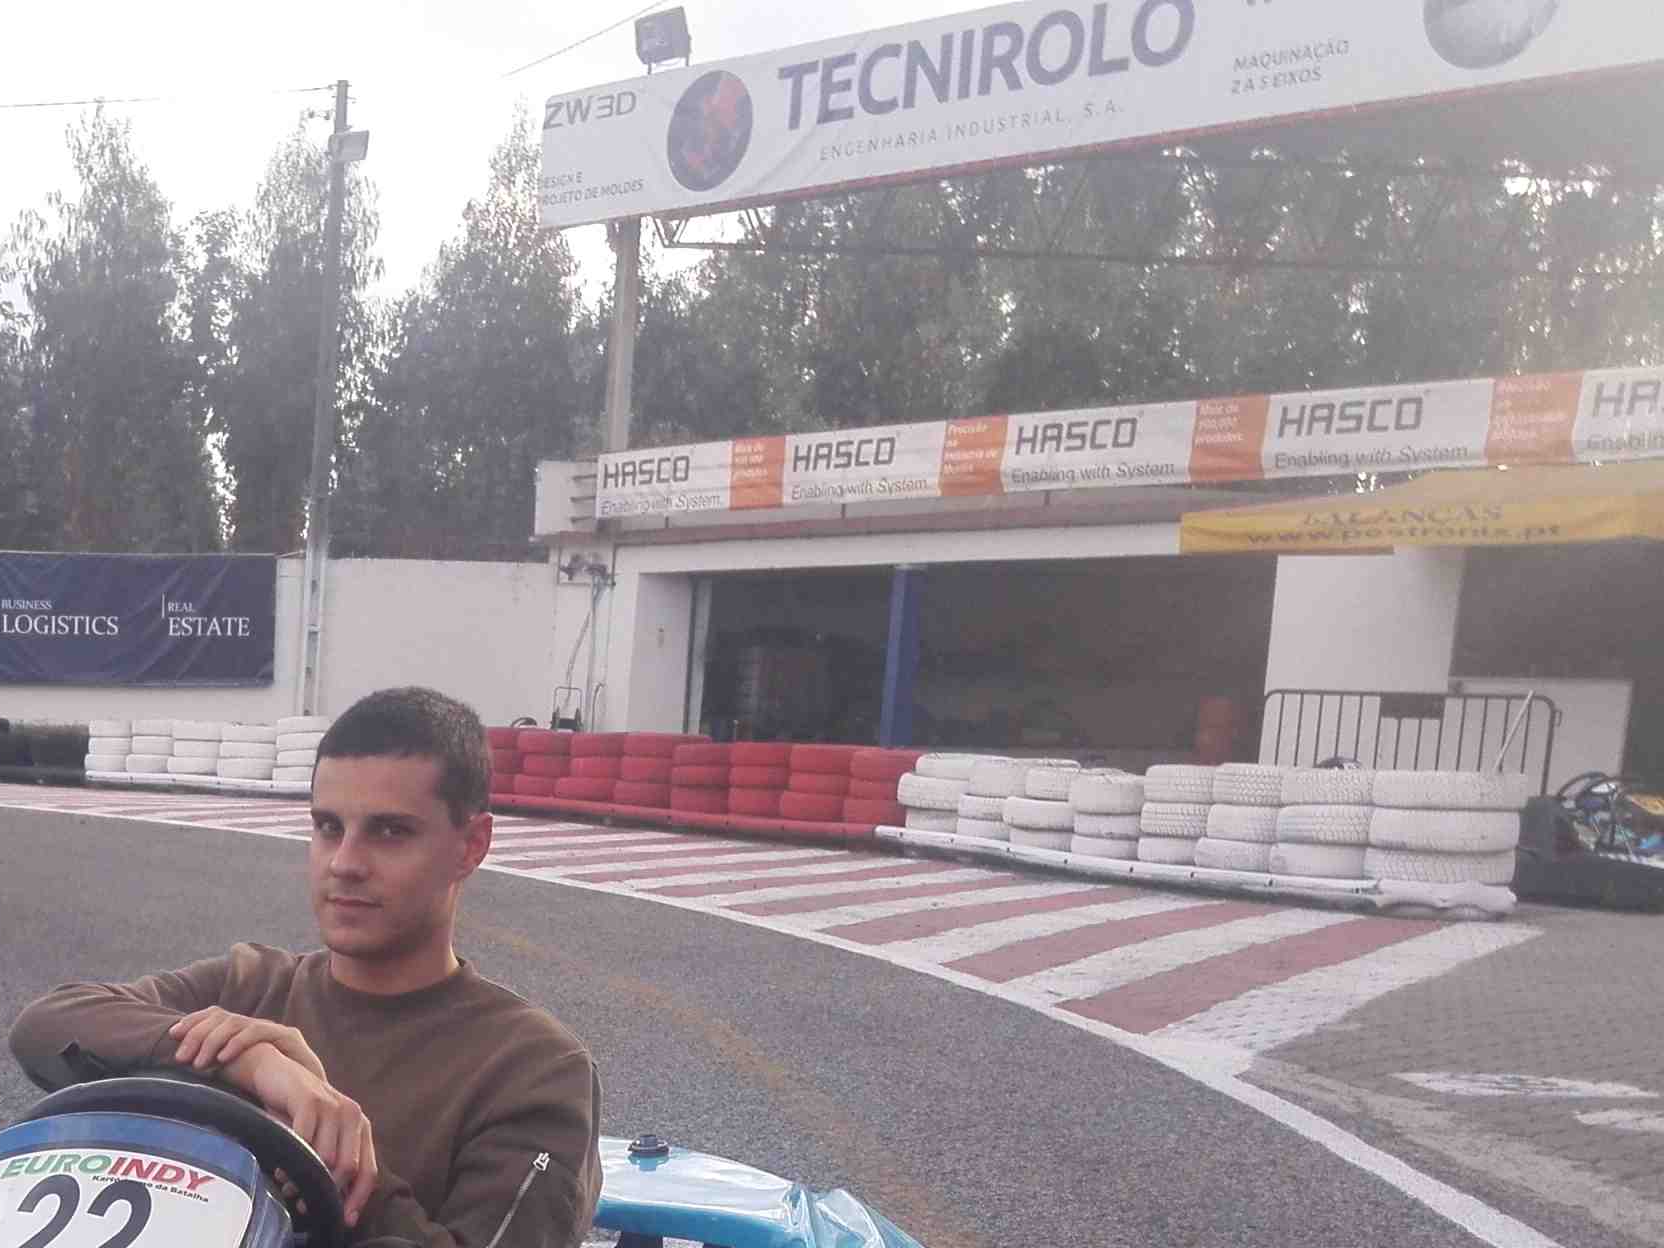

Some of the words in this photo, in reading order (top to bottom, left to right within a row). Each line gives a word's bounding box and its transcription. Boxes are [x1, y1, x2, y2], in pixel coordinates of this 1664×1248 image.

[778, 0, 1196, 131] TECNIROLO
[819, 128, 938, 161] ENGENHARIA
[1592, 379, 1664, 417] HA
[1277, 396, 1424, 438] HASCO
[1015, 417, 1138, 455] HASCO
[792, 436, 896, 473] HASCO
[1274, 452, 1351, 470] Enabling
[1355, 449, 1392, 466] with
[1398, 444, 1468, 463] System
[602, 455, 690, 489] HASCO
[1011, 467, 1075, 485] Enabling
[1079, 464, 1111, 480] with
[1116, 462, 1176, 479] System
[1, 598, 53, 611] BUSINESS
[167, 601, 196, 613] REAL
[1, 613, 120, 637] LOGISTICS
[167, 616, 251, 638] ESTATE
[0, 1152, 217, 1191] EUROINDY
[170, 1186, 209, 1203] Batalha
